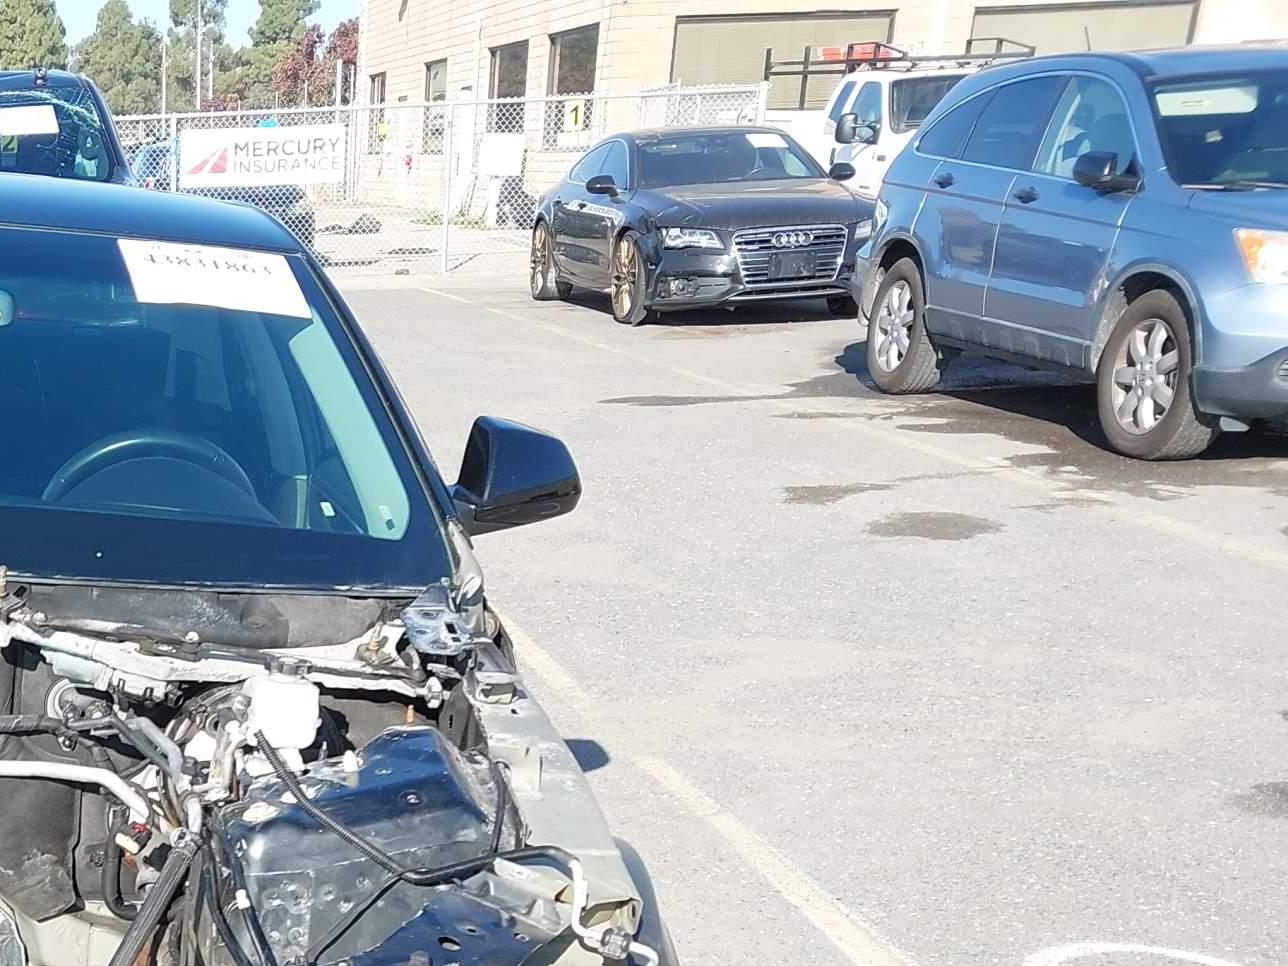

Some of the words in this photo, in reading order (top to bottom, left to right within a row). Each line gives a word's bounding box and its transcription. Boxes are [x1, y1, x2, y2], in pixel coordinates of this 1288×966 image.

[570, 104, 579, 126] 1
[233, 137, 340, 158] MERCURY
[233, 156, 340, 174] INSURANCE
